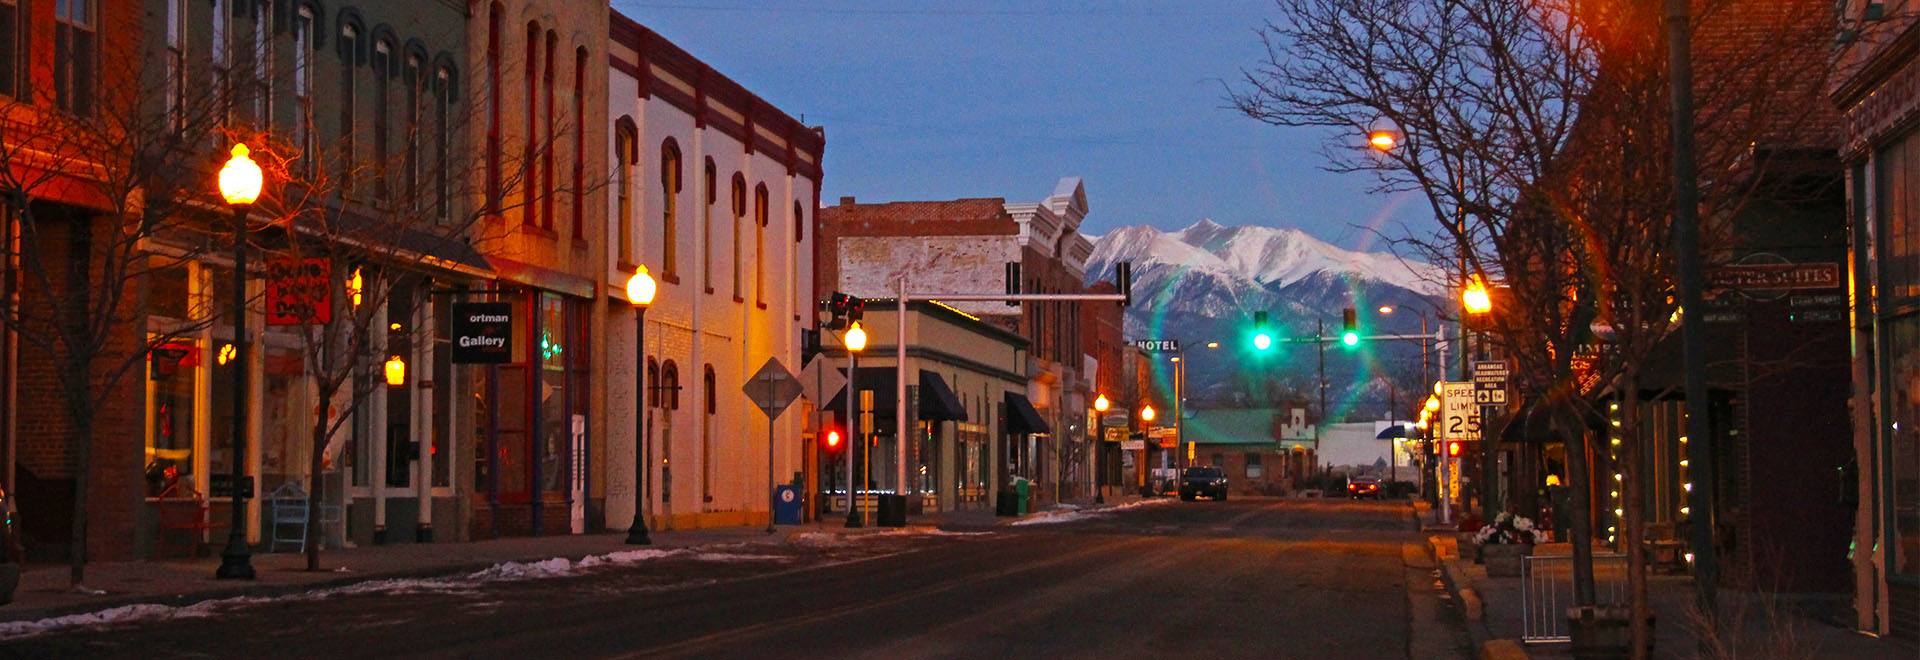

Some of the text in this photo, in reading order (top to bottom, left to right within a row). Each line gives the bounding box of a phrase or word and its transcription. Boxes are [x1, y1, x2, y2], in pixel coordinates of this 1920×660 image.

[459, 335, 505, 348] Gallery
[1137, 340, 1177, 351] HOTEL
[1447, 389, 1475, 398] SPEE
[1449, 416, 1481, 433] 25
